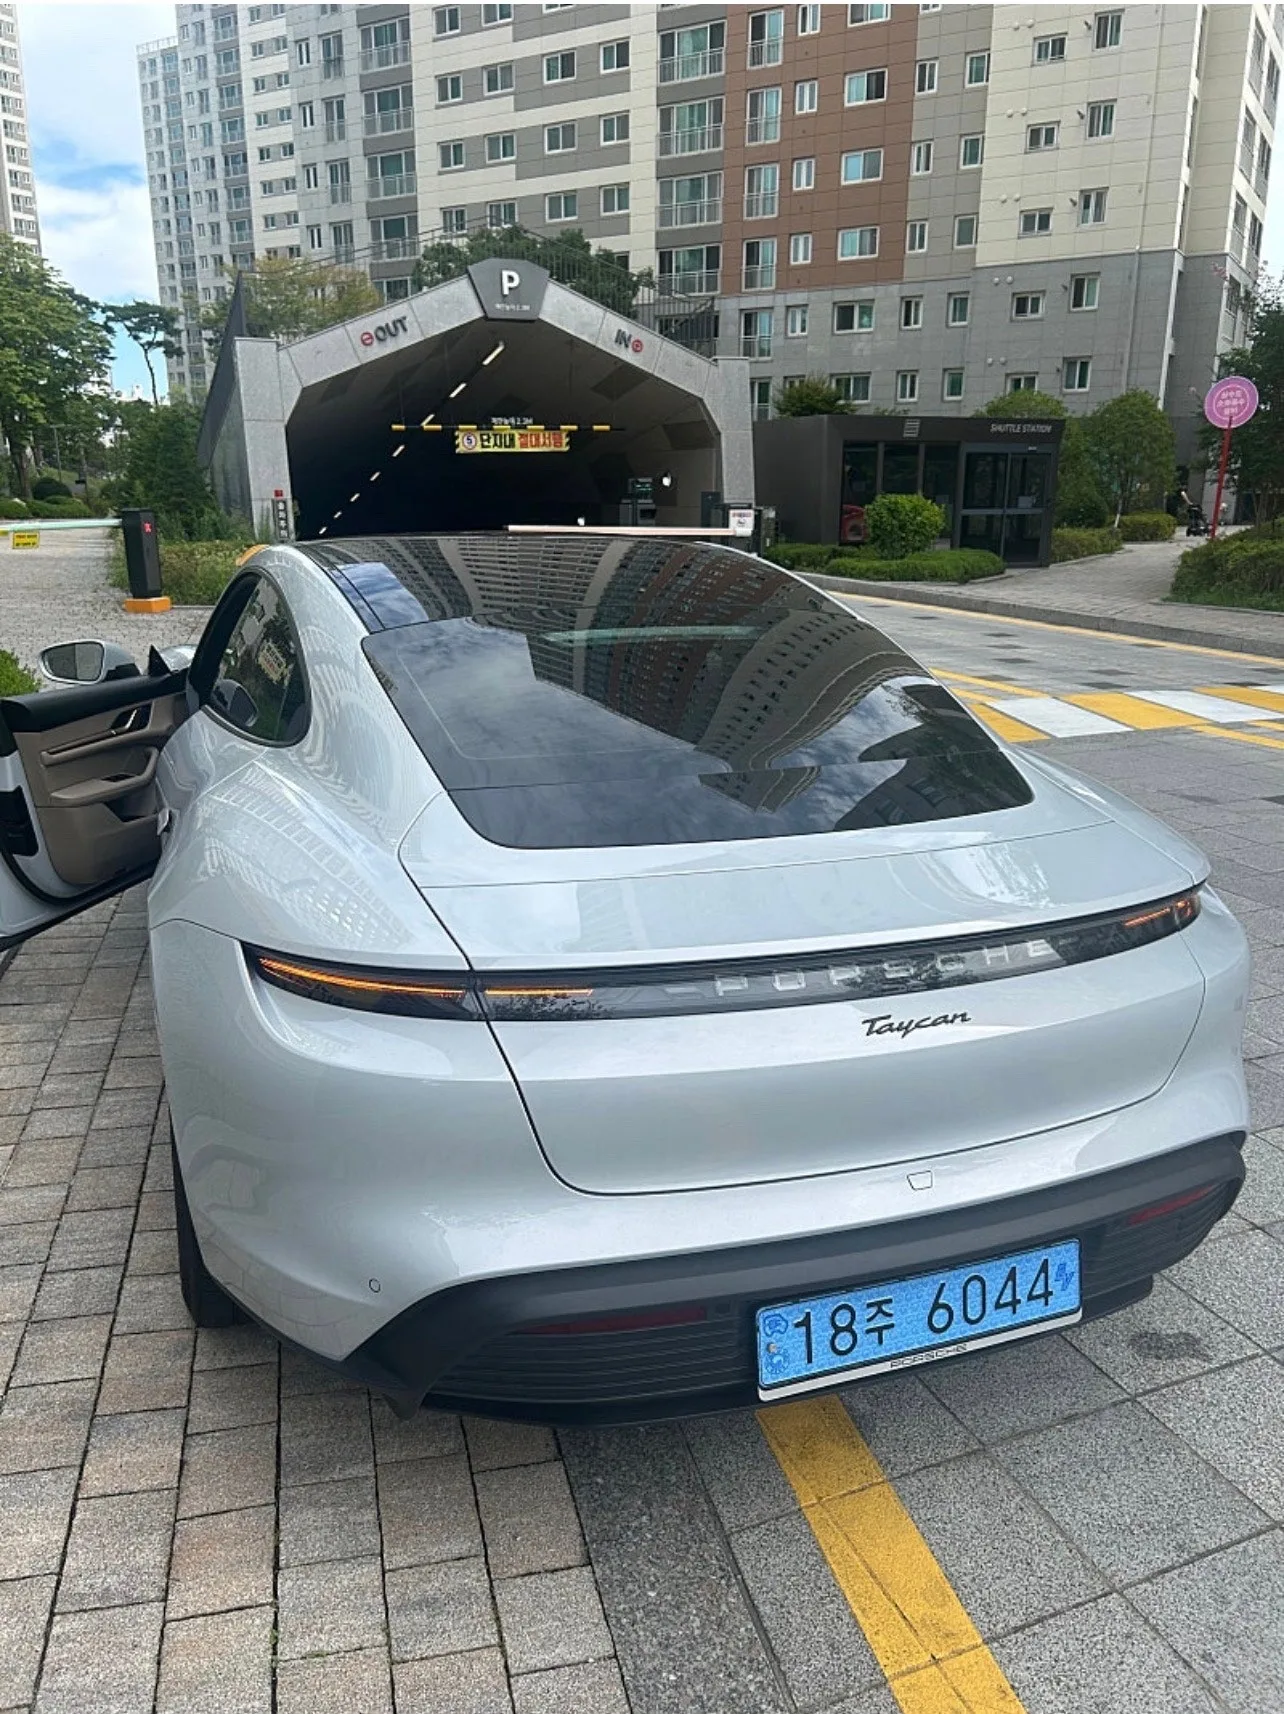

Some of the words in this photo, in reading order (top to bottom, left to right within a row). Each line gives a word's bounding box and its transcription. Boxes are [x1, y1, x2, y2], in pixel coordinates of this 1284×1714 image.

[501, 269, 520, 295] P
[374, 316, 408, 340] OUT
[614, 329, 632, 348] IN
[480, 433, 515, 449] 단지내
[517, 432, 563, 449] 절대서행
[989, 423, 1022, 434] SHUTTLE
[1022, 423, 1053, 434] STATION
[715, 938, 1055, 997] PORSCHE
[861, 1009, 972, 1038] Taycan
[793, 1297, 896, 1364] 18주
[927, 1258, 1054, 1335] 6044
